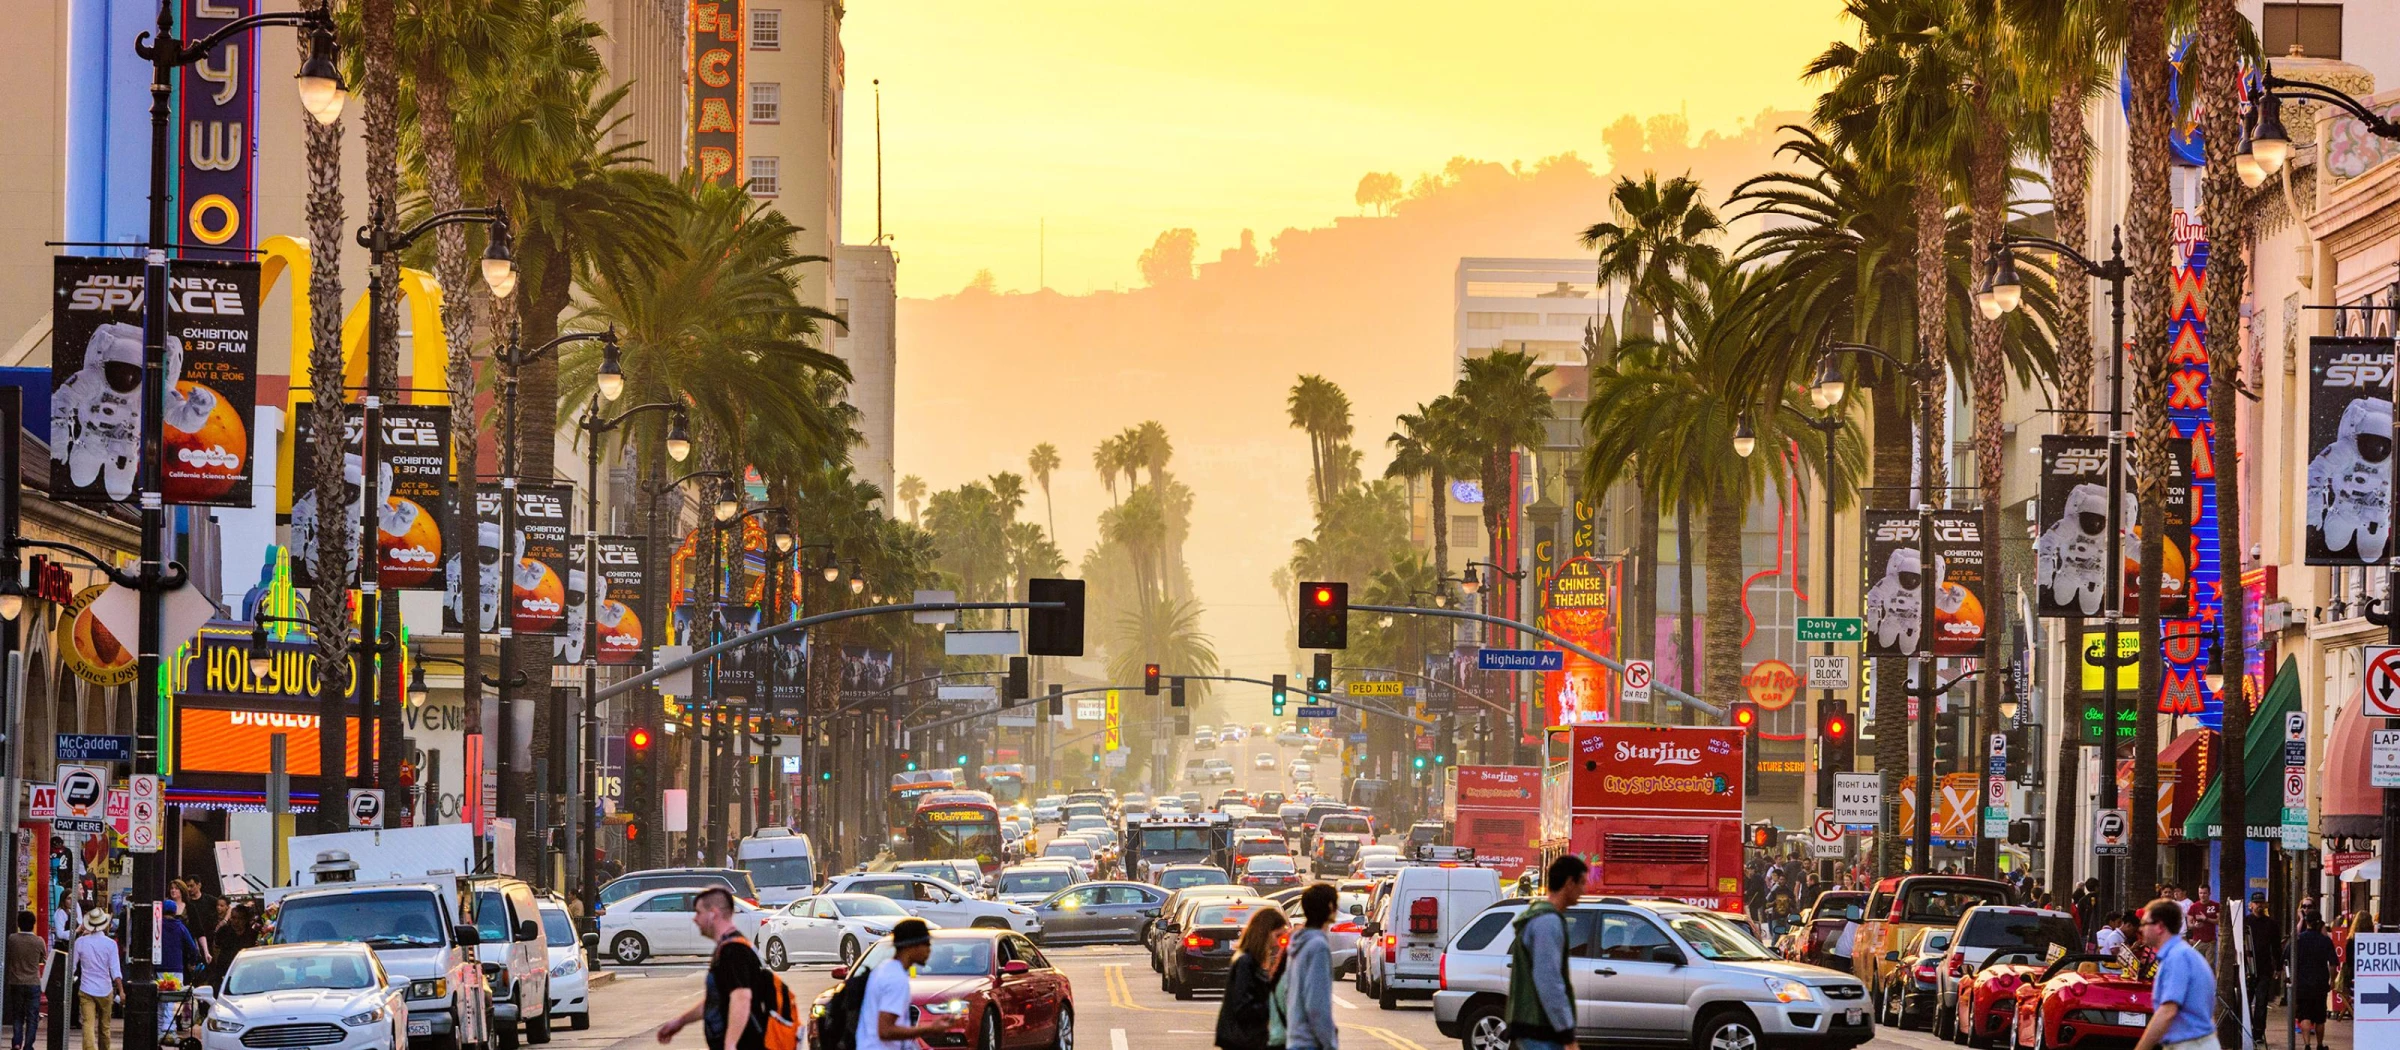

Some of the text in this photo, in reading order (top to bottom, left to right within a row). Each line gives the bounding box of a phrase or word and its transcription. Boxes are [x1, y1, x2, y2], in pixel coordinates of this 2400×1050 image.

[697, 3, 738, 41] EL
[217, 283, 238, 291] TO
[183, 328, 248, 341] EXHIBITION
[2169, 266, 2209, 410] WAX
[184, 341, 246, 353] & 3D FILM
[216, 363, 231, 371] 29
[187, 371, 244, 380] MAY 2016
[2322, 366, 2393, 387] SP
[392, 456, 443, 465] EXHIBITION
[393, 466, 400, 474] &
[419, 467, 441, 475] FILM
[168, 471, 200, 479] California
[226, 473, 248, 481] Center
[1570, 562, 1589, 576] TCL
[1558, 577, 1600, 591] CHINESE
[1553, 593, 1605, 607] THEATRES
[1807, 620, 1837, 630] Dolby
[1801, 631, 1843, 639] Theatre
[1486, 654, 1556, 667] Highland Av
[1814, 659, 1844, 668] DO NOT
[73, 660, 139, 683] Since 1989
[1816, 669, 1842, 679] BLOCK
[1352, 683, 1399, 693] PED XING
[1761, 693, 1782, 701] CAFE
[1301, 708, 1321, 716] Orange
[1107, 696, 1117, 744] INN
[59, 735, 118, 750] McCadden
[1593, 735, 1602, 743] On
[1709, 738, 1730, 749] Hop On
[2375, 734, 2400, 744] LAP
[59, 749, 128, 759] 1700 N Pl
[1708, 745, 1719, 753] Hop
[732, 760, 741, 796] ZARA
[1842, 795, 1877, 803] MUST
[928, 811, 946, 822] 780
[57, 820, 100, 832] PAY HERE
[2246, 825, 2282, 838] GALORE
[1816, 845, 1842, 853] ON RED
[2111, 847, 2127, 855] HERE
[1680, 898, 1719, 909] PON
